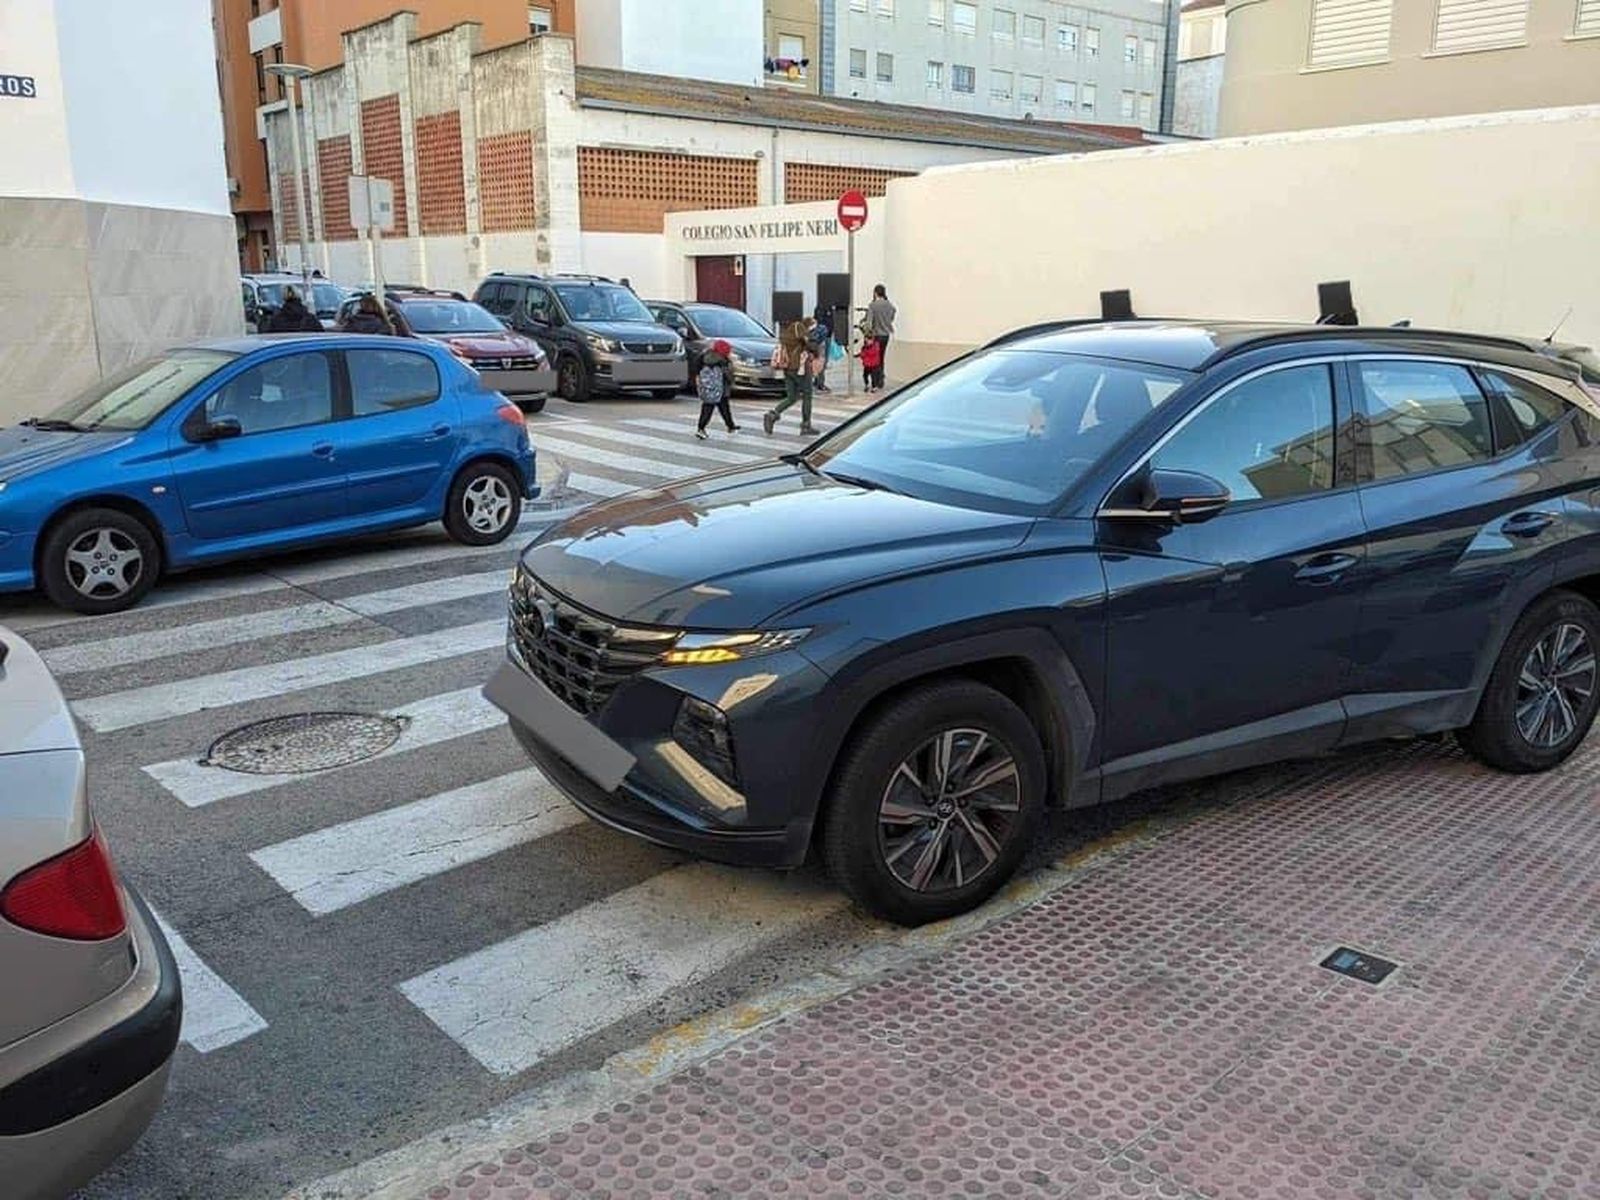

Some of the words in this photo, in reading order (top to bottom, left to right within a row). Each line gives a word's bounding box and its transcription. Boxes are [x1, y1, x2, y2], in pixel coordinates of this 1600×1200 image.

[682, 225, 733, 241] COLEGIO
[734, 223, 760, 239] SAN
[761, 220, 804, 239] FELIPE
[806, 218, 838, 237] NERI
